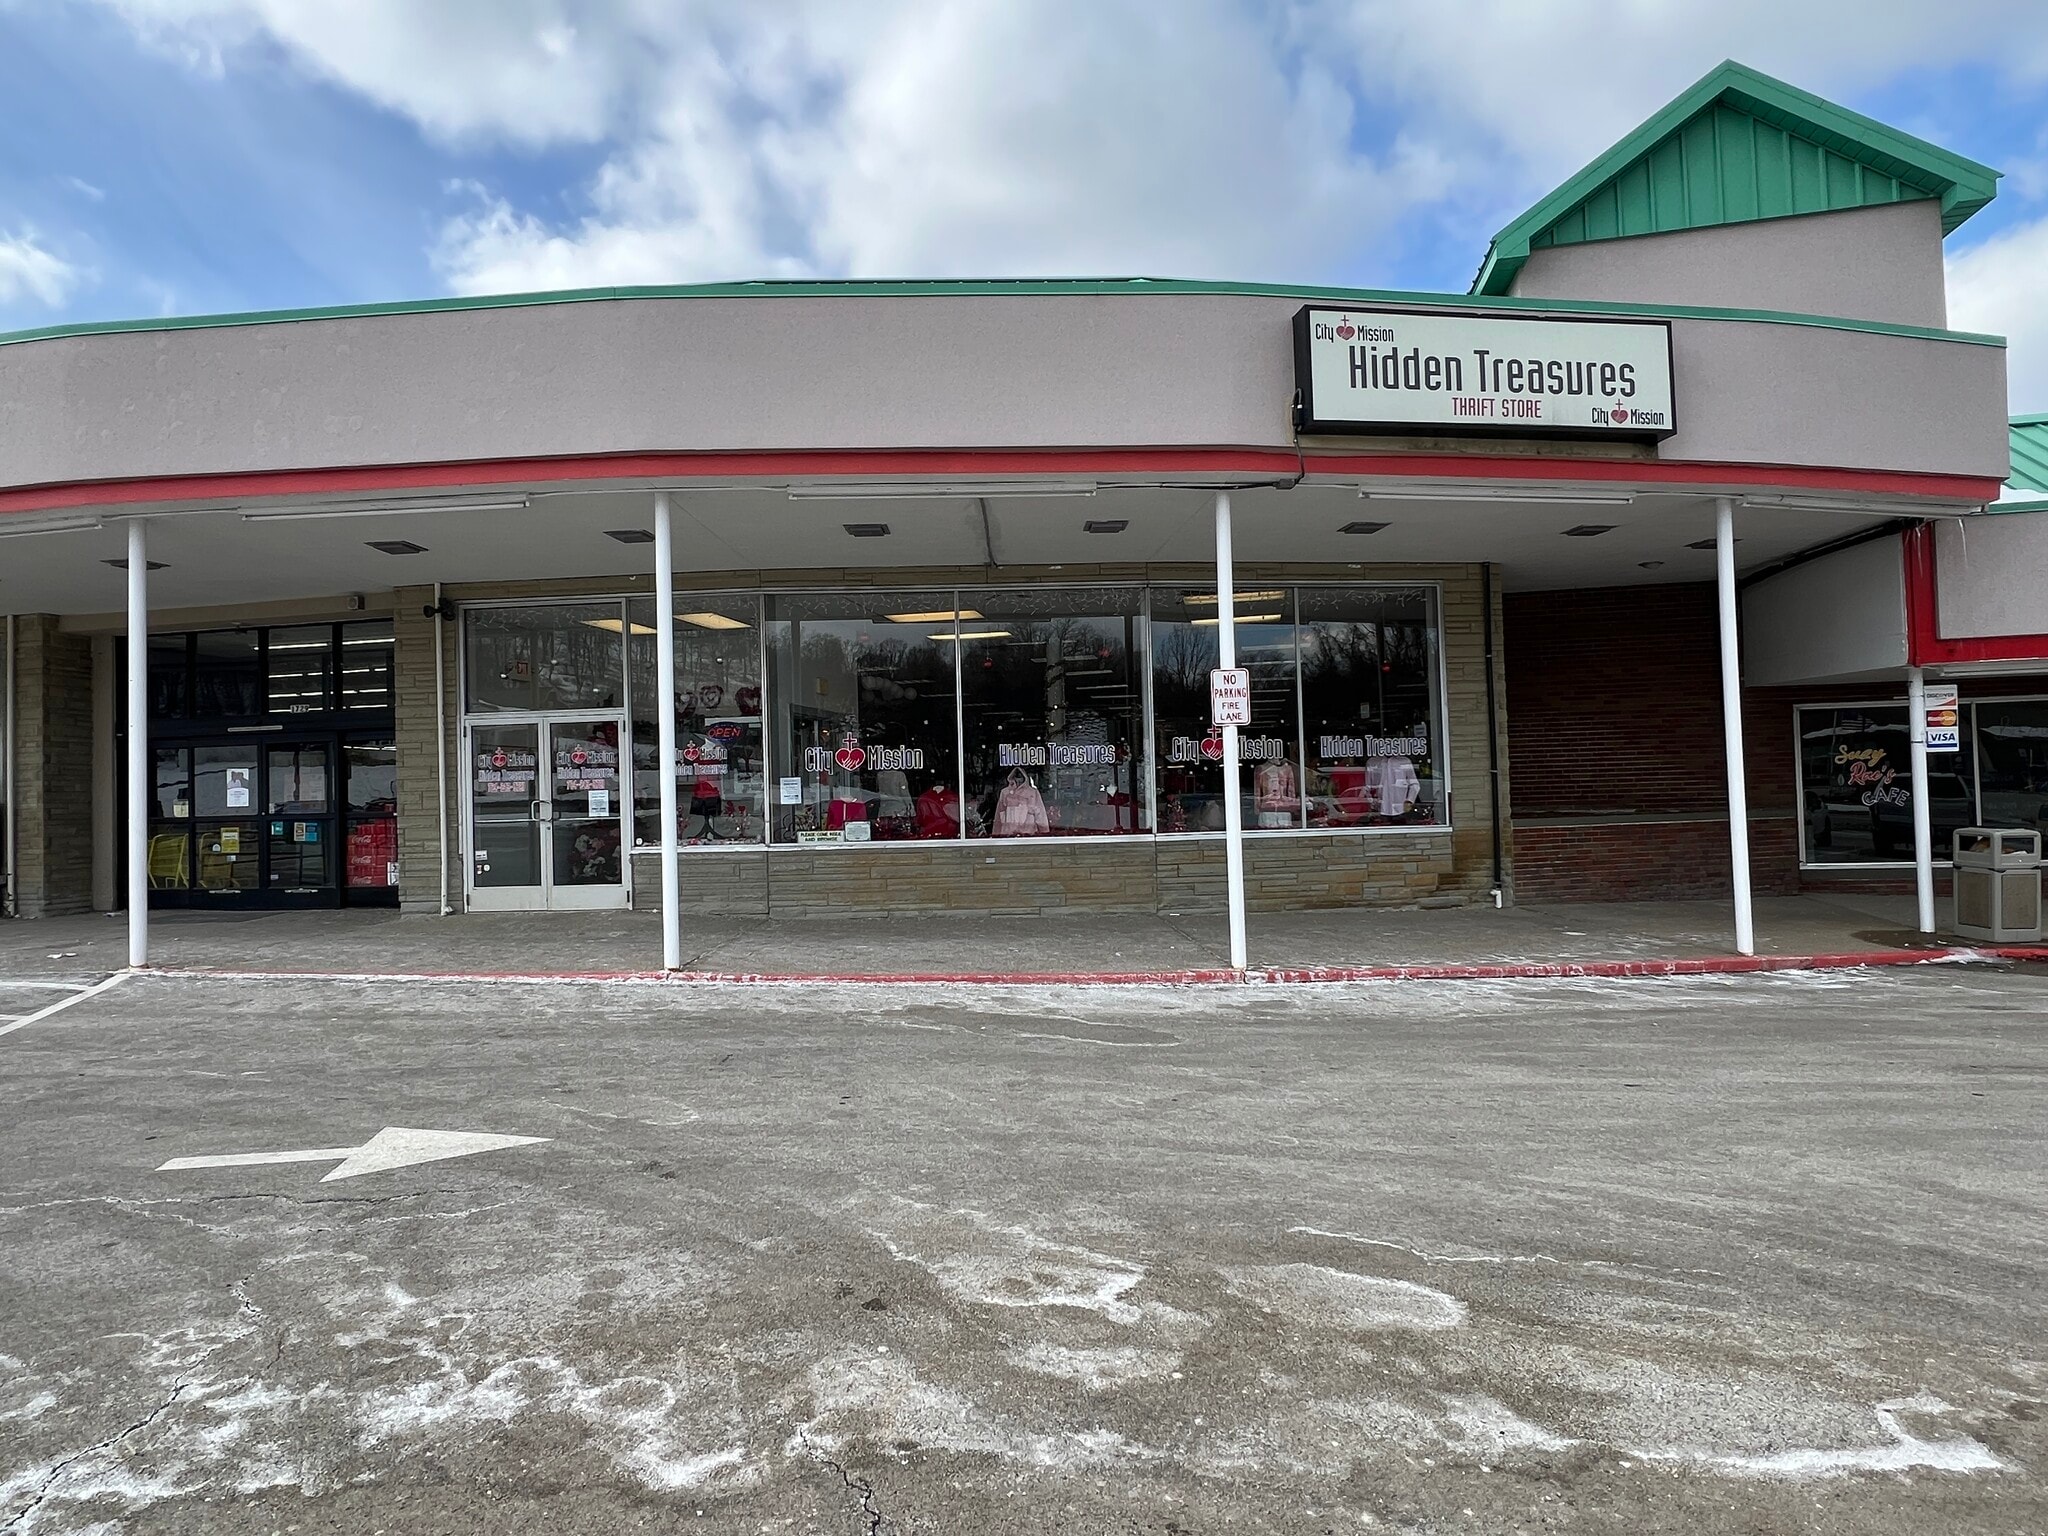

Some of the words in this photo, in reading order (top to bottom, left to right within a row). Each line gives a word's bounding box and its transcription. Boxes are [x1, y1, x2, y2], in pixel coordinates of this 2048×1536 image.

[1315, 324, 1334, 343] City
[1357, 325, 1394, 342] Mission
[1349, 345, 1462, 391] Hidden
[1473, 350, 1636, 397] Treasures
[1452, 397, 1495, 416] THRIFT
[1502, 399, 1542, 418] STORE
[1591, 407, 1609, 426] City
[1630, 409, 1665, 425] Mission
[1223, 674, 1237, 685] NO
[1215, 687, 1247, 698] PARKING
[1221, 701, 1240, 710] FIRE
[1220, 712, 1243, 721] LANE
[708, 728, 741, 738] OPEN
[1930, 733, 1956, 741] VISA
[999, 743, 1046, 766] Hidden
[1047, 742, 1116, 765] Treasures
[1172, 736, 1199, 765] City
[1320, 735, 1363, 758] Hidden
[1365, 735, 1427, 757] Treasures
[1834, 744, 1887, 767] Suzy
[804, 747, 834, 775] City
[867, 745, 923, 770] Mission
[1848, 761, 1896, 785] Rae's
[1861, 786, 1910, 807] CAFE
